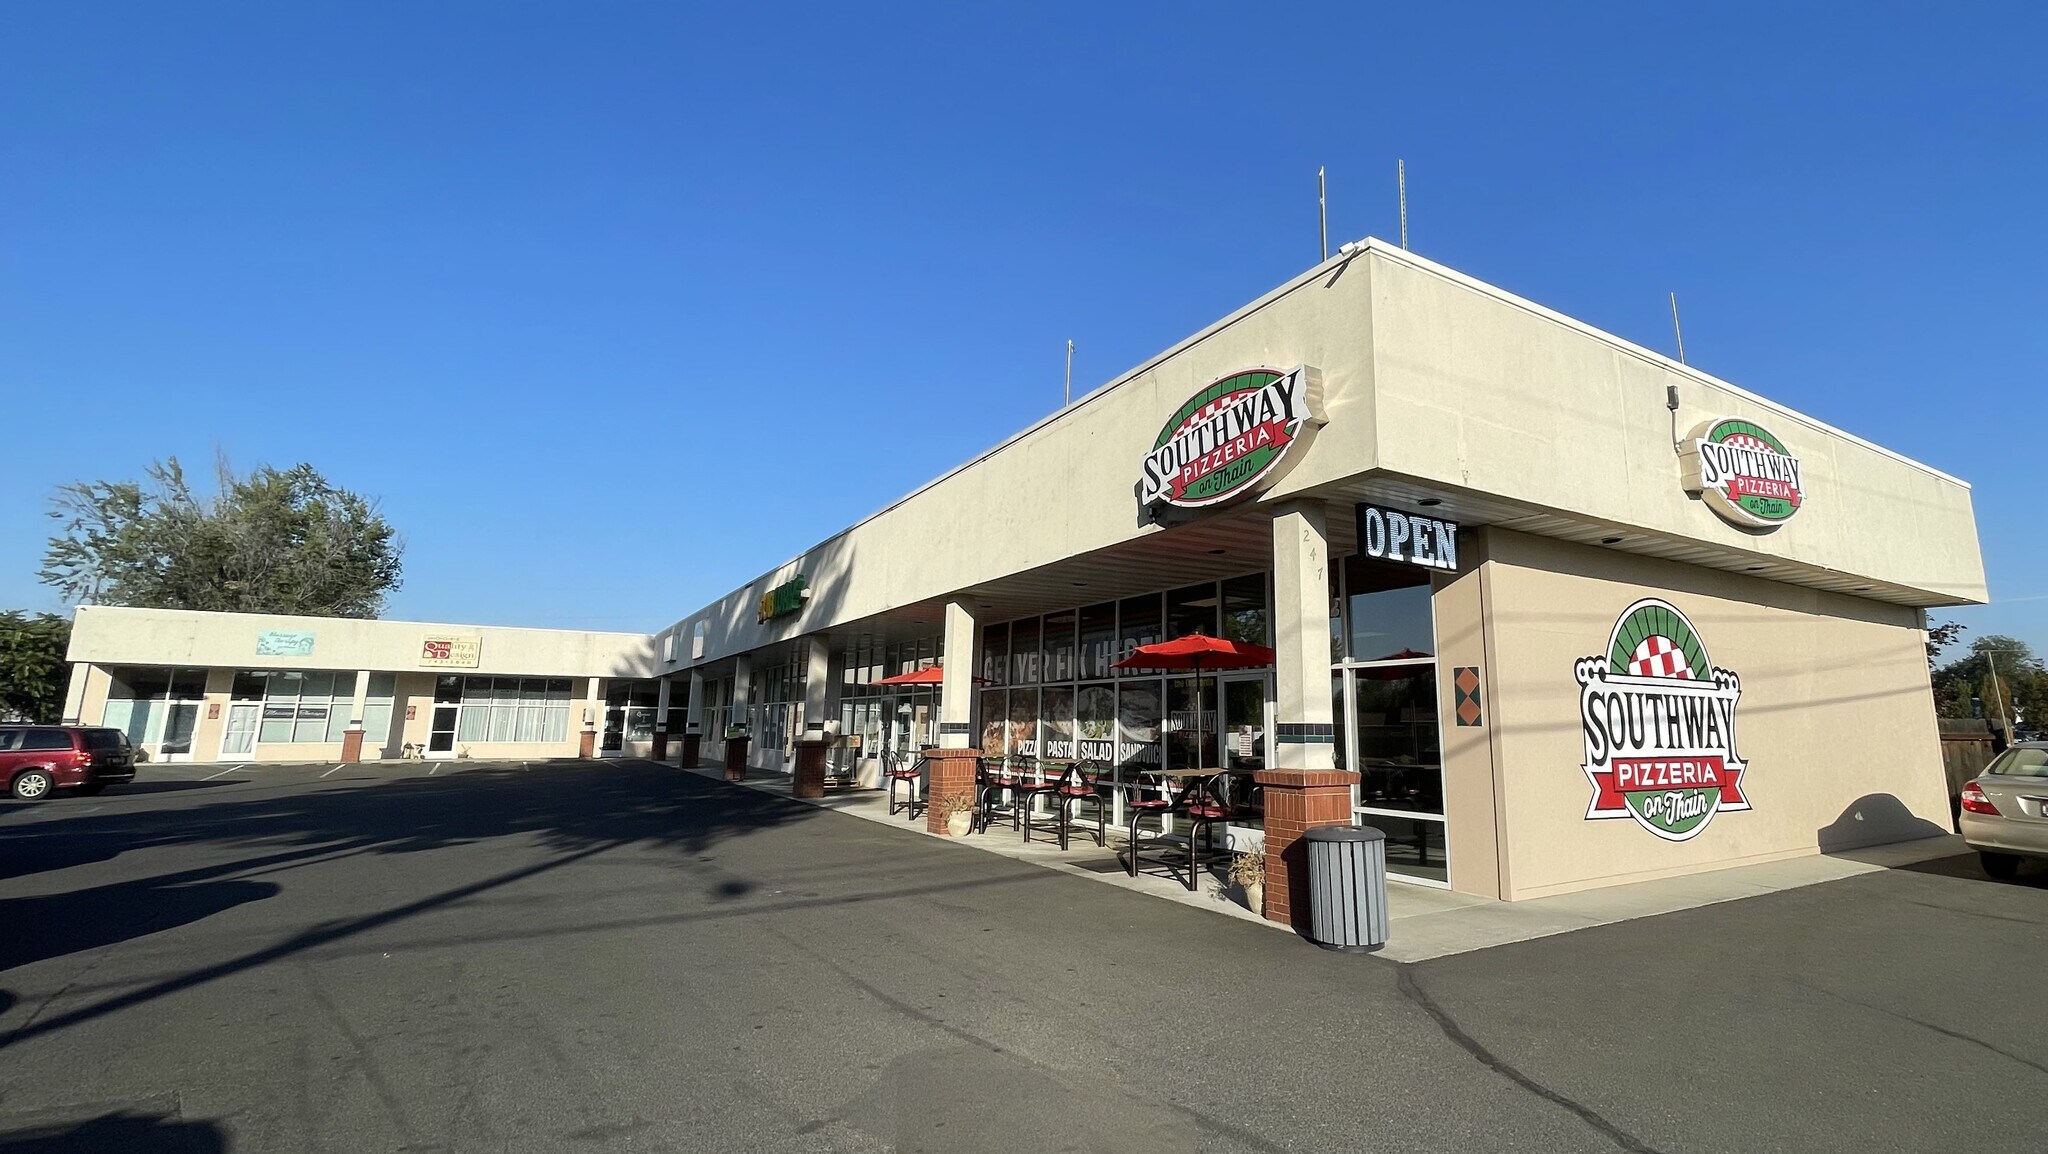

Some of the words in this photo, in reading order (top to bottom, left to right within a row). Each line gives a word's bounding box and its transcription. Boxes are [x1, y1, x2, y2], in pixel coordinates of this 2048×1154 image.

[1144, 369, 1301, 497] SOUTHWAY
[1183, 426, 1270, 483] PIZZERIA
[1701, 443, 1800, 492] SOUTHWAY
[1199, 481, 1212, 494] on
[1213, 458, 1254, 491] Thain
[1737, 478, 1791, 498] PIZZERIA
[1750, 499, 1759, 509] on
[1760, 497, 1783, 514] Thain
[1365, 507, 1457, 570] OPEN
[1017, 649, 1050, 685] YER
[1587, 691, 1734, 766] SOUTHWAY
[1047, 740, 1073, 759] PASTA
[1081, 741, 1113, 762] SALAD
[1618, 763, 1717, 787] PIZZERIA
[1643, 796, 1664, 818] on
[1663, 788, 1707, 826] Thain
